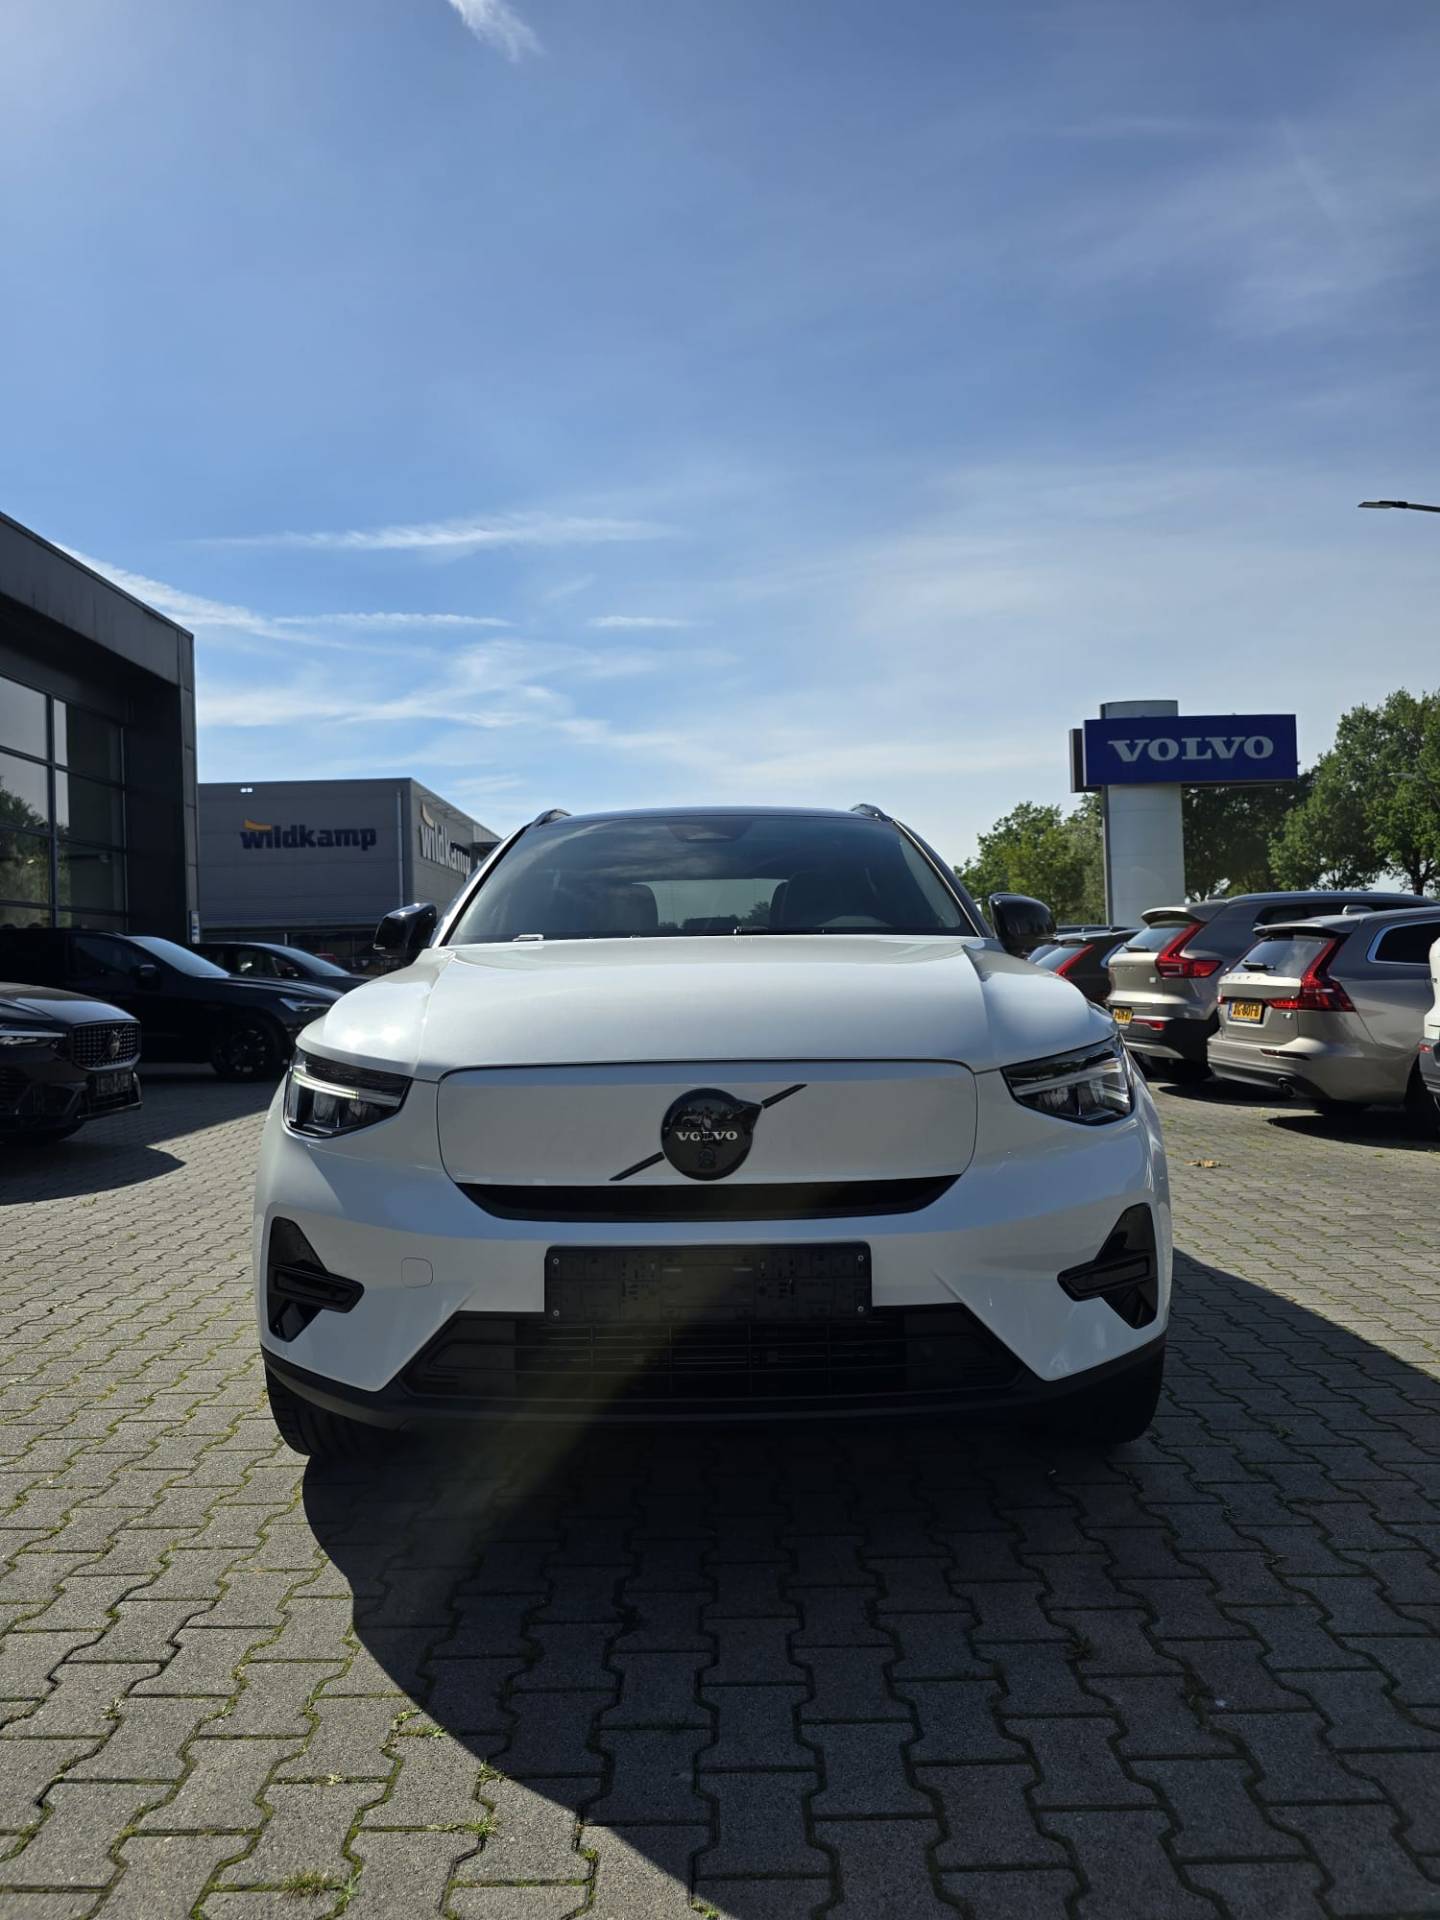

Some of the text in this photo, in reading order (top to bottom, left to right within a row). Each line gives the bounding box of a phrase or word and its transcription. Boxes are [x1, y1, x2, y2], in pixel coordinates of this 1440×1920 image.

[1107, 735, 1275, 763] VOLVO
[239, 821, 377, 851] wildkamp
[675, 1130, 738, 1141] VOLVO
